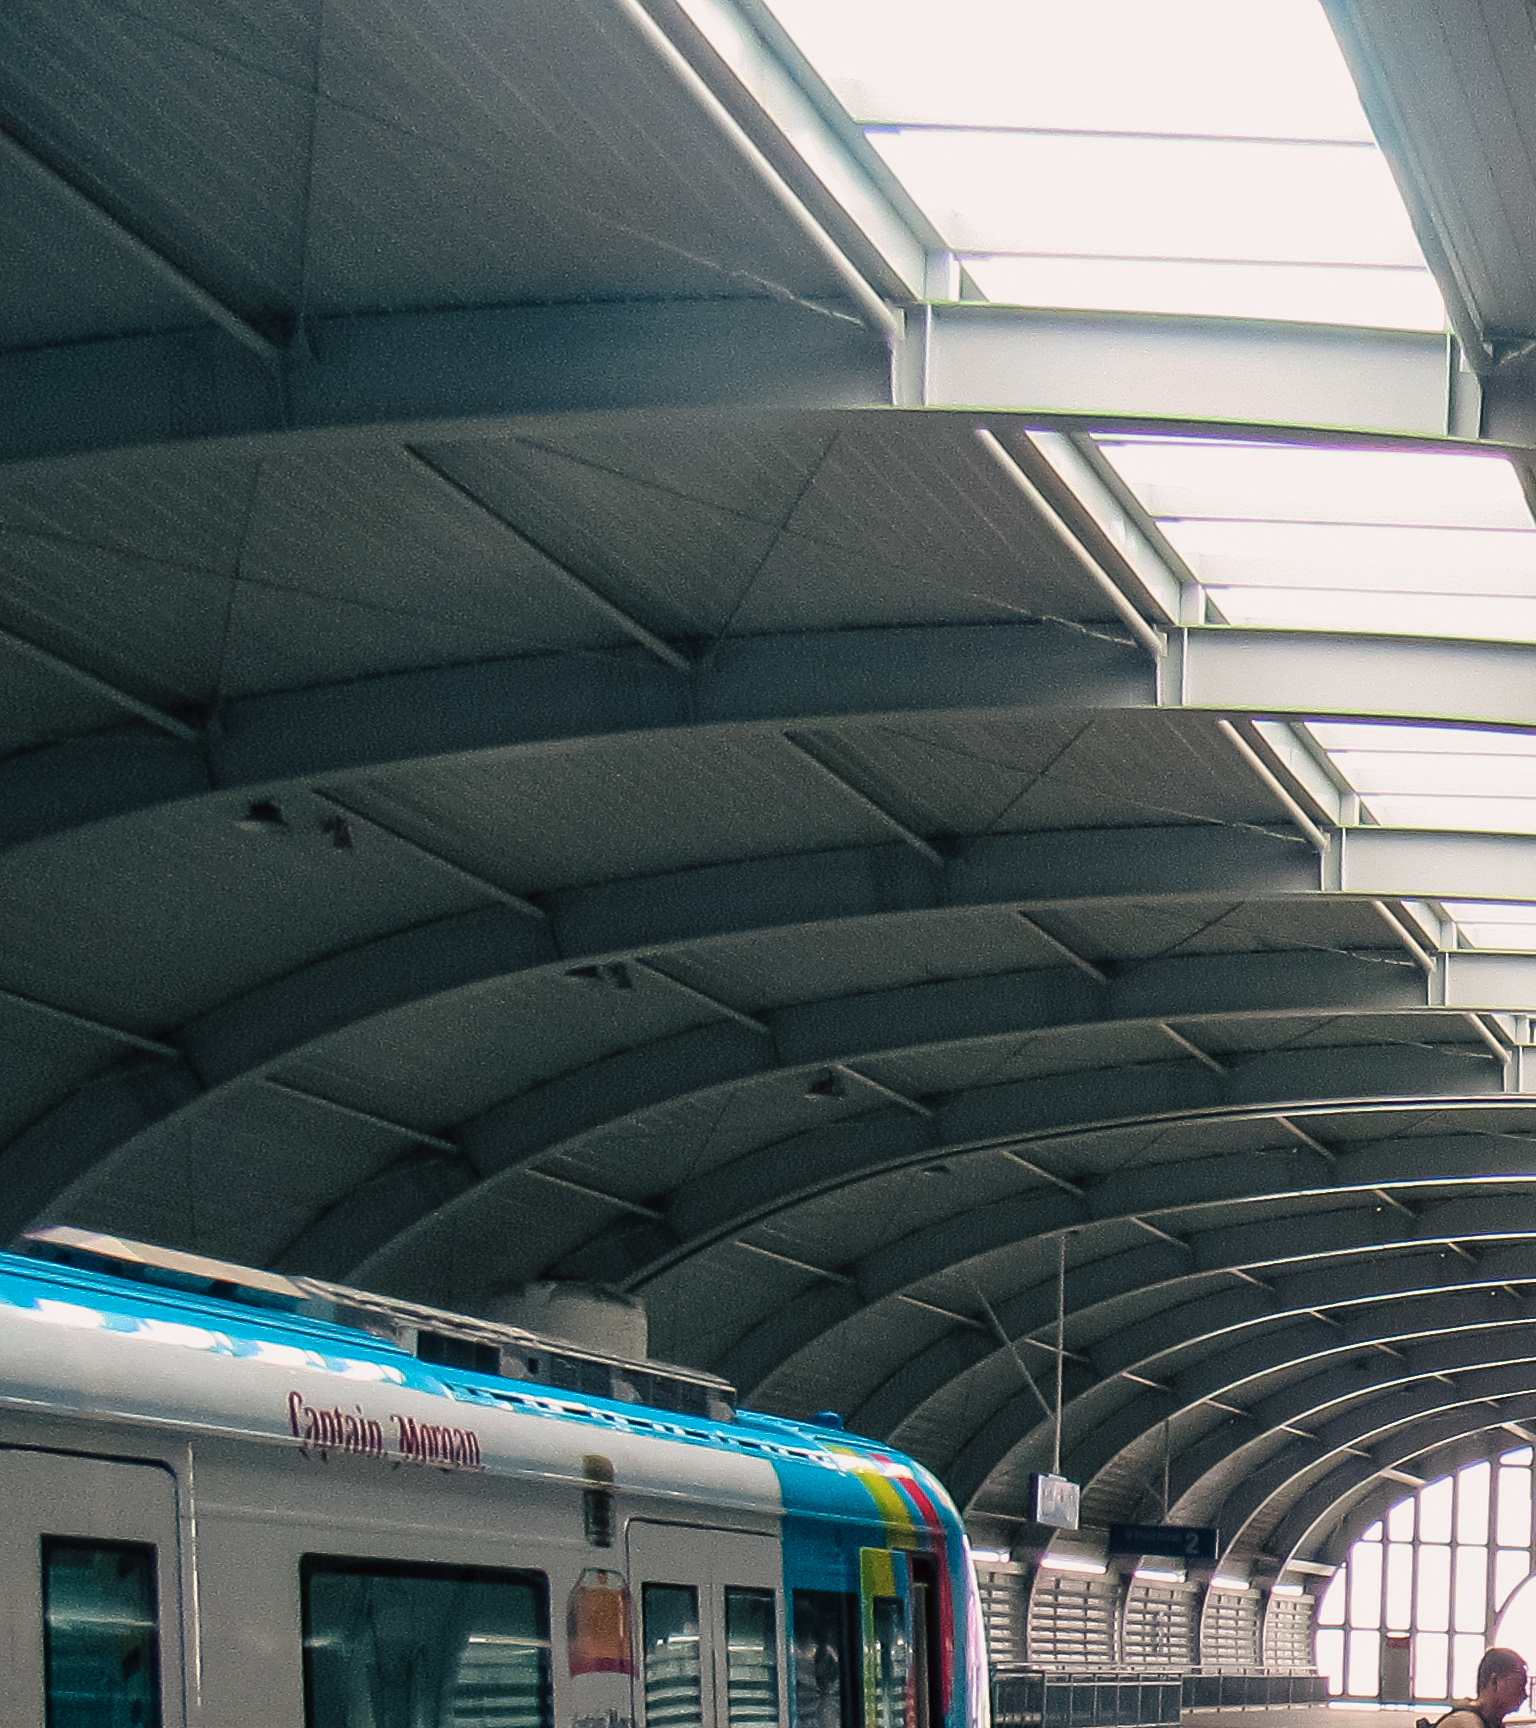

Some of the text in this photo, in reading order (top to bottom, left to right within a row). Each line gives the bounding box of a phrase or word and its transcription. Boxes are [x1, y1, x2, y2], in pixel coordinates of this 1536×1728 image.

[288, 1391, 483, 1474] Captain Morgan
[1185, 1532, 1199, 1554] 2
